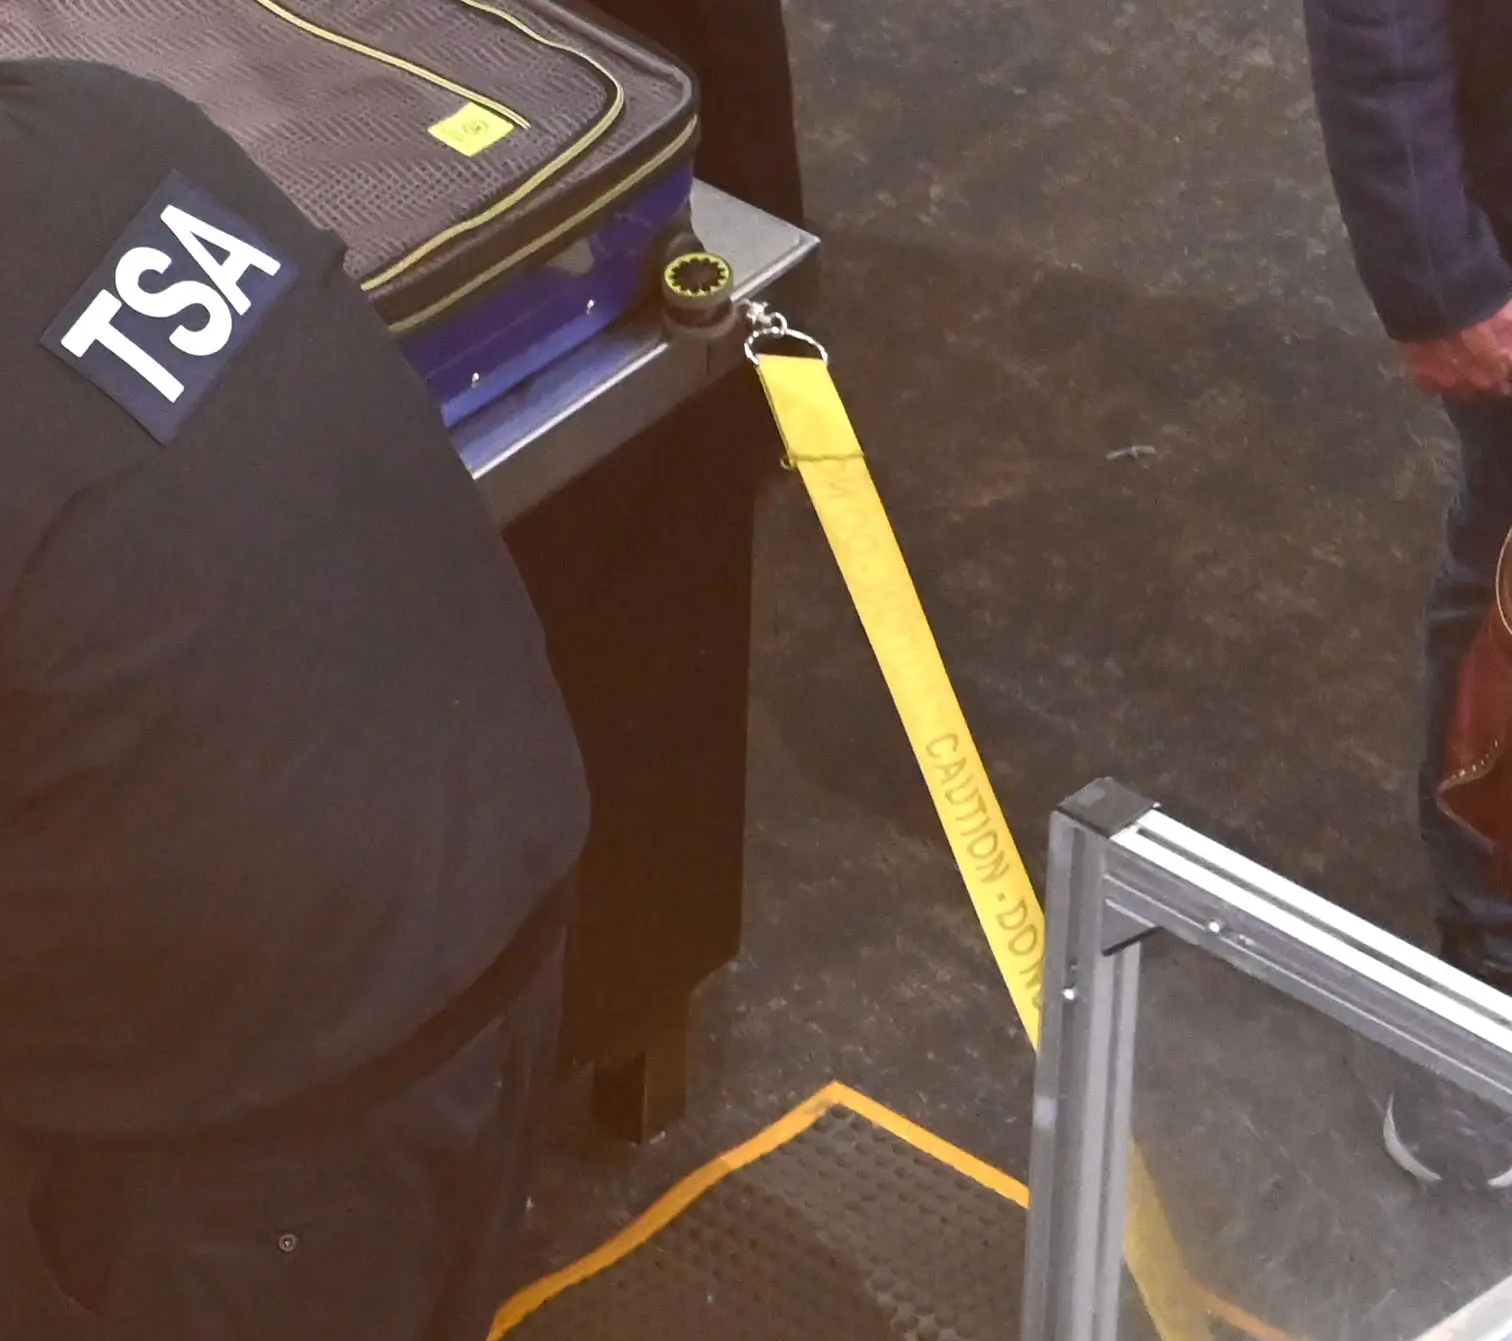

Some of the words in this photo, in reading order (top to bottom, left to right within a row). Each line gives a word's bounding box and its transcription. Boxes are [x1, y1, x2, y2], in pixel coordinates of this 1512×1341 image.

[58, 204, 284, 405] TSA
[926, 732, 1010, 885] CAUTION
[996, 900, 1038, 957] DO
